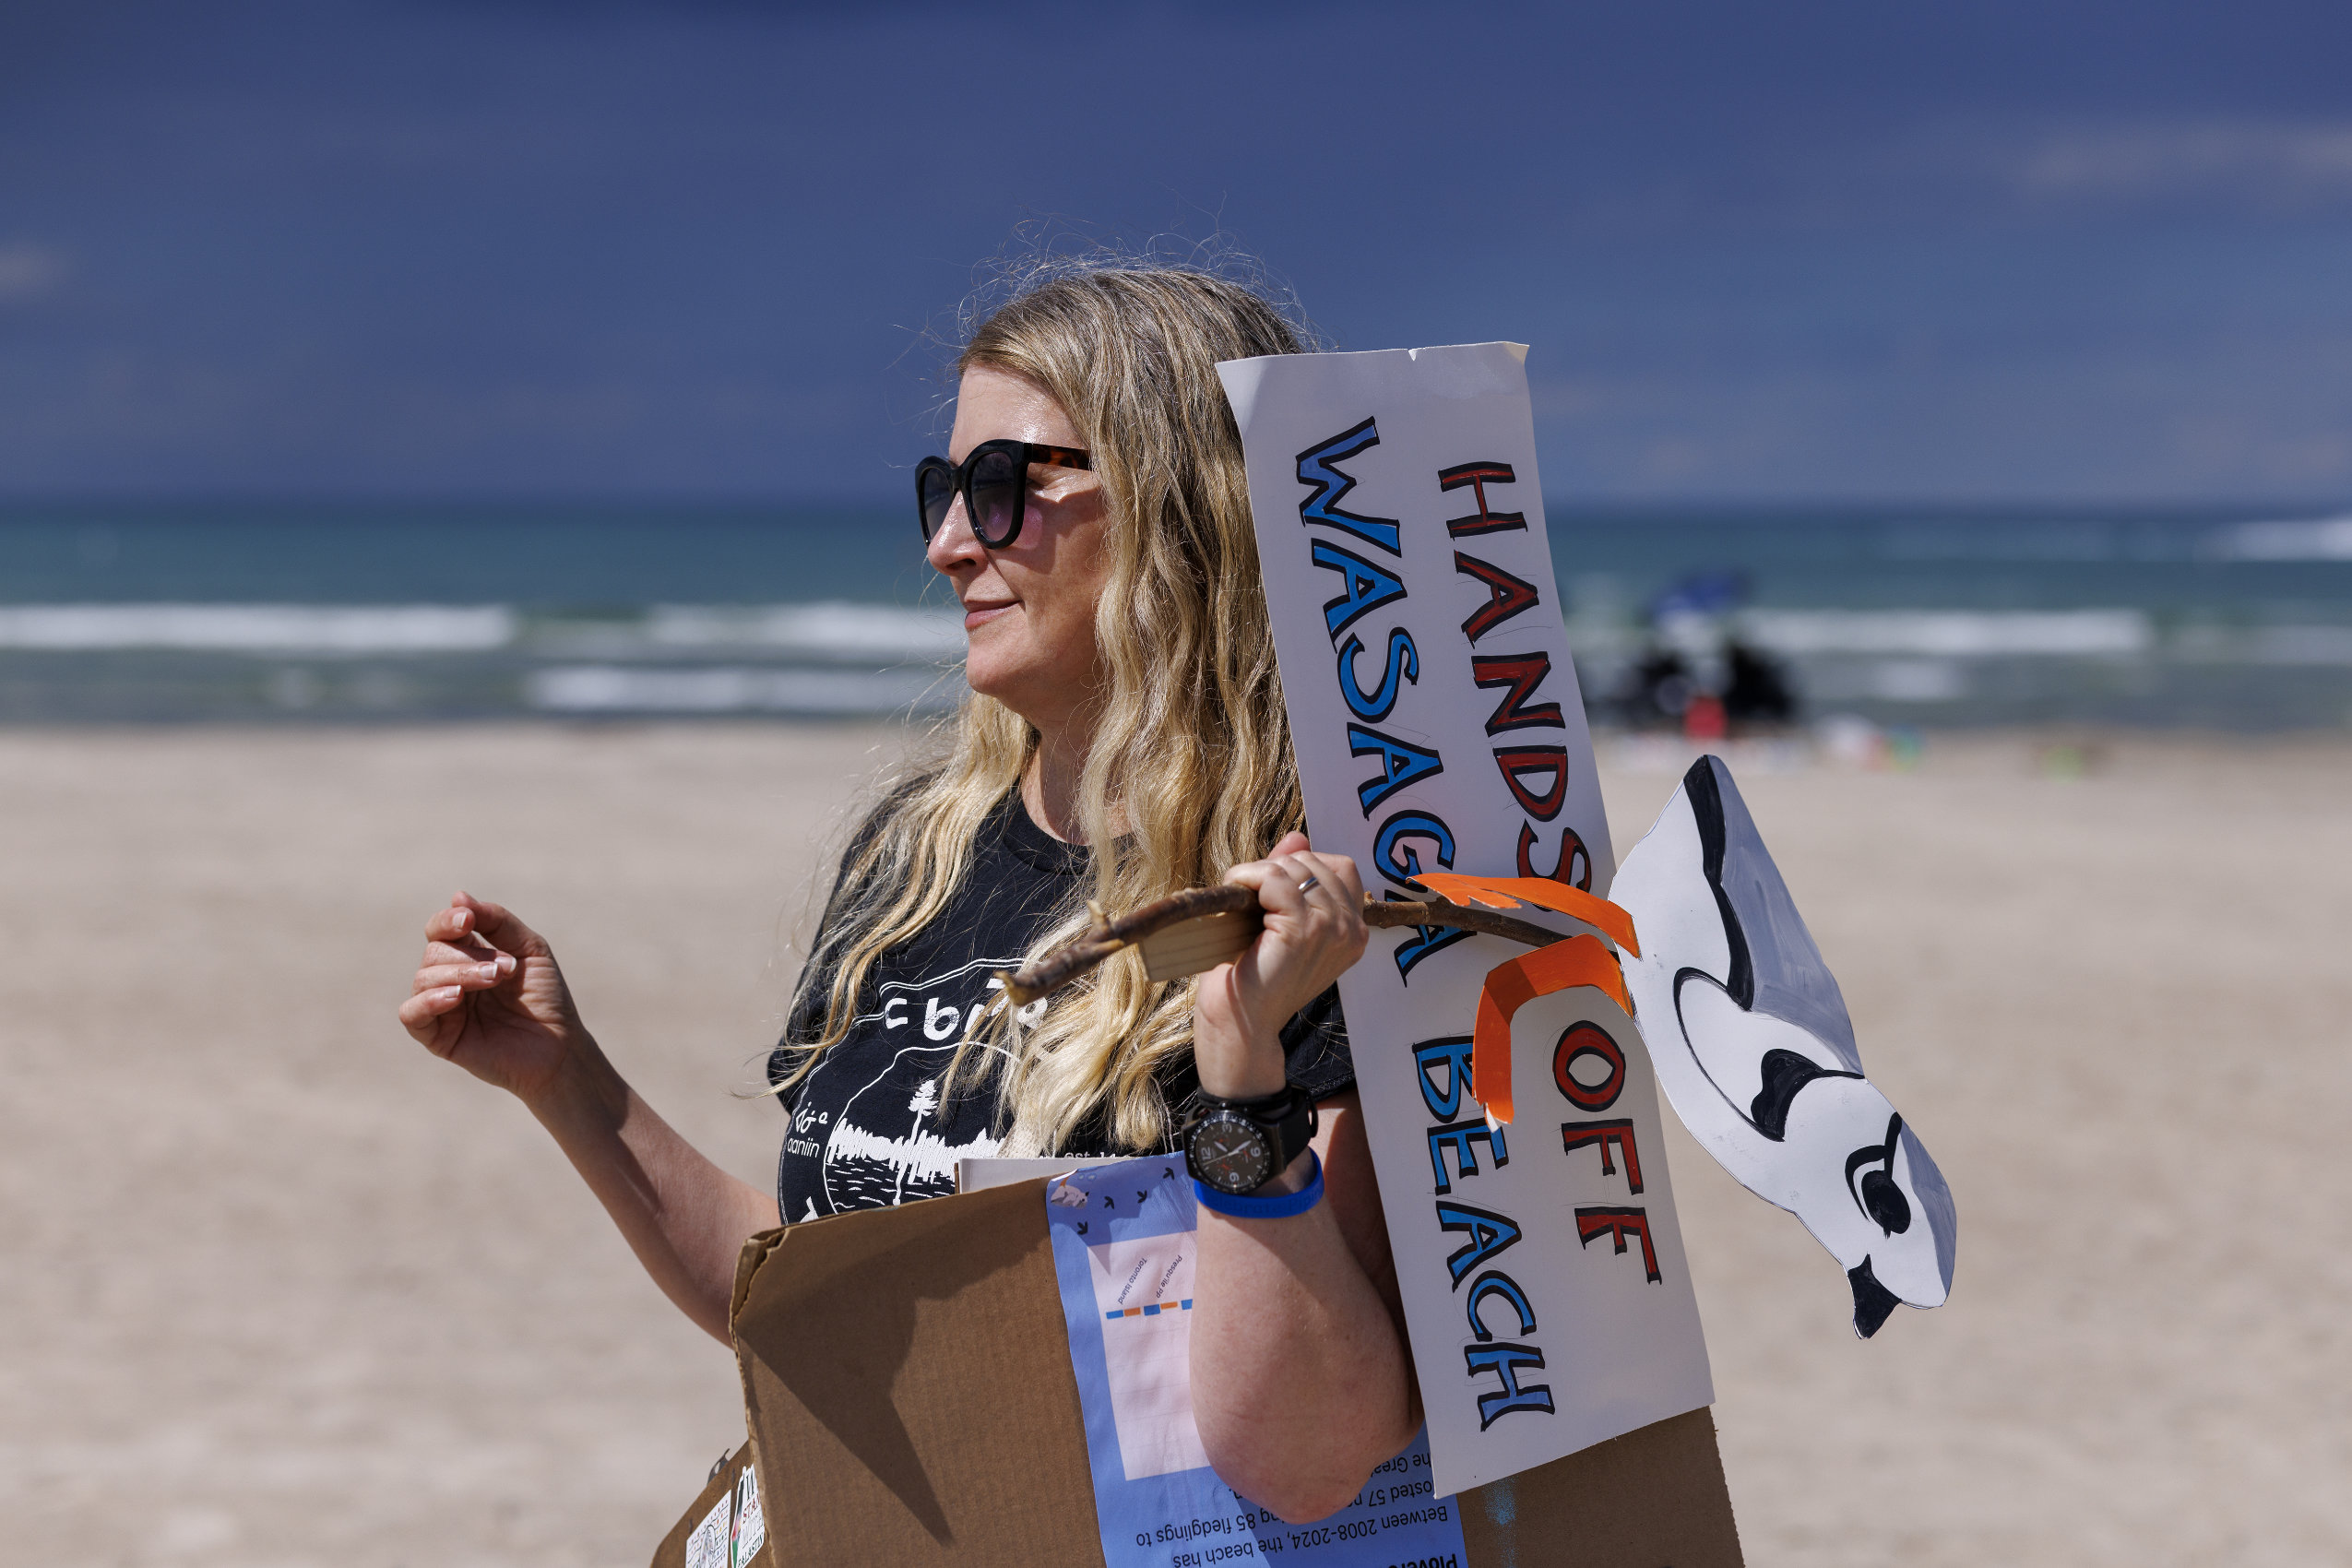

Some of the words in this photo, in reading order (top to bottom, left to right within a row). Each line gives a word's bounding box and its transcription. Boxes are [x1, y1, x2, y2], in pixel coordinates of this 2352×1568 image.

[1439, 461, 1592, 912] HANDS
[1552, 1019, 1662, 1285] OFF
[1295, 415, 1478, 988] WASAGA
[1412, 1035, 1555, 1432] BEACH
[1222, 1123, 1232, 1133] 3
[787, 1137, 820, 1158] aaniin
[1201, 1146, 1211, 1160] 12
[1250, 1146, 1261, 1157] 6
[1229, 1172, 1240, 1182] 9
[1130, 1257, 1147, 1284] Toronto
[1117, 1282, 1133, 1305] Island
[1369, 1489, 1386, 1507] 57
[1390, 1480, 1433, 1503] osted
[1236, 1513, 1256, 1531] 85
[1381, 1505, 1448, 1528] Between
[1136, 1532, 1153, 1547] to
[1157, 1517, 1232, 1543] fledglings
[1287, 1518, 1377, 1550] 2008-2024,
[1206, 1542, 1254, 1565] beach
[1258, 1537, 1284, 1553] the
[1172, 1551, 1202, 1568] has
